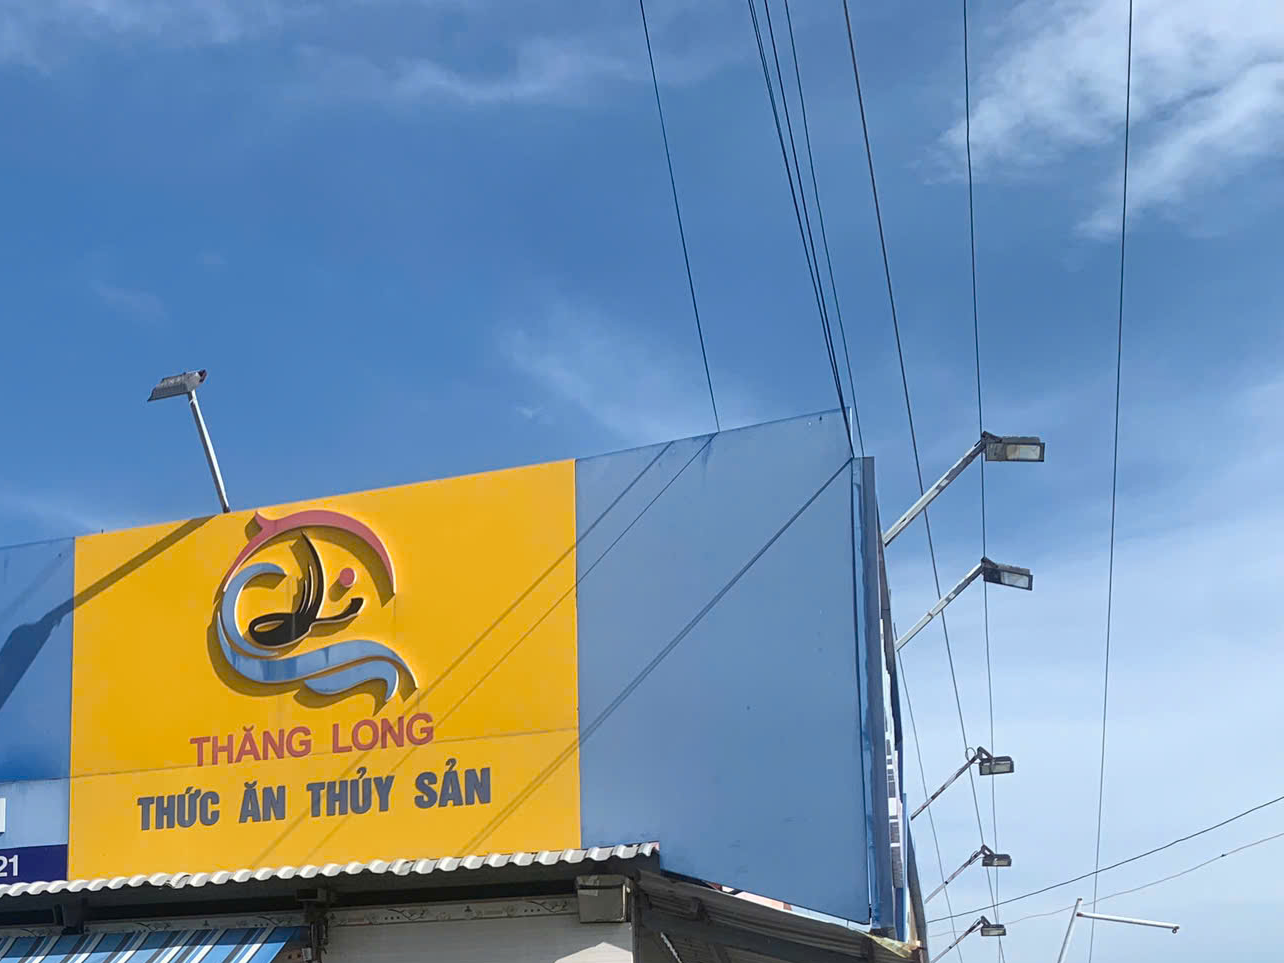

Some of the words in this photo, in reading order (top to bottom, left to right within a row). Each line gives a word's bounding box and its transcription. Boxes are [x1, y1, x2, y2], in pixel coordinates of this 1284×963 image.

[190, 725, 312, 767] THĂNG
[332, 712, 435, 753] LONG
[137, 785, 220, 830] THỨC
[239, 781, 286, 823] ĂN
[307, 767, 393, 817] THỦY
[414, 758, 491, 808] SẢN
